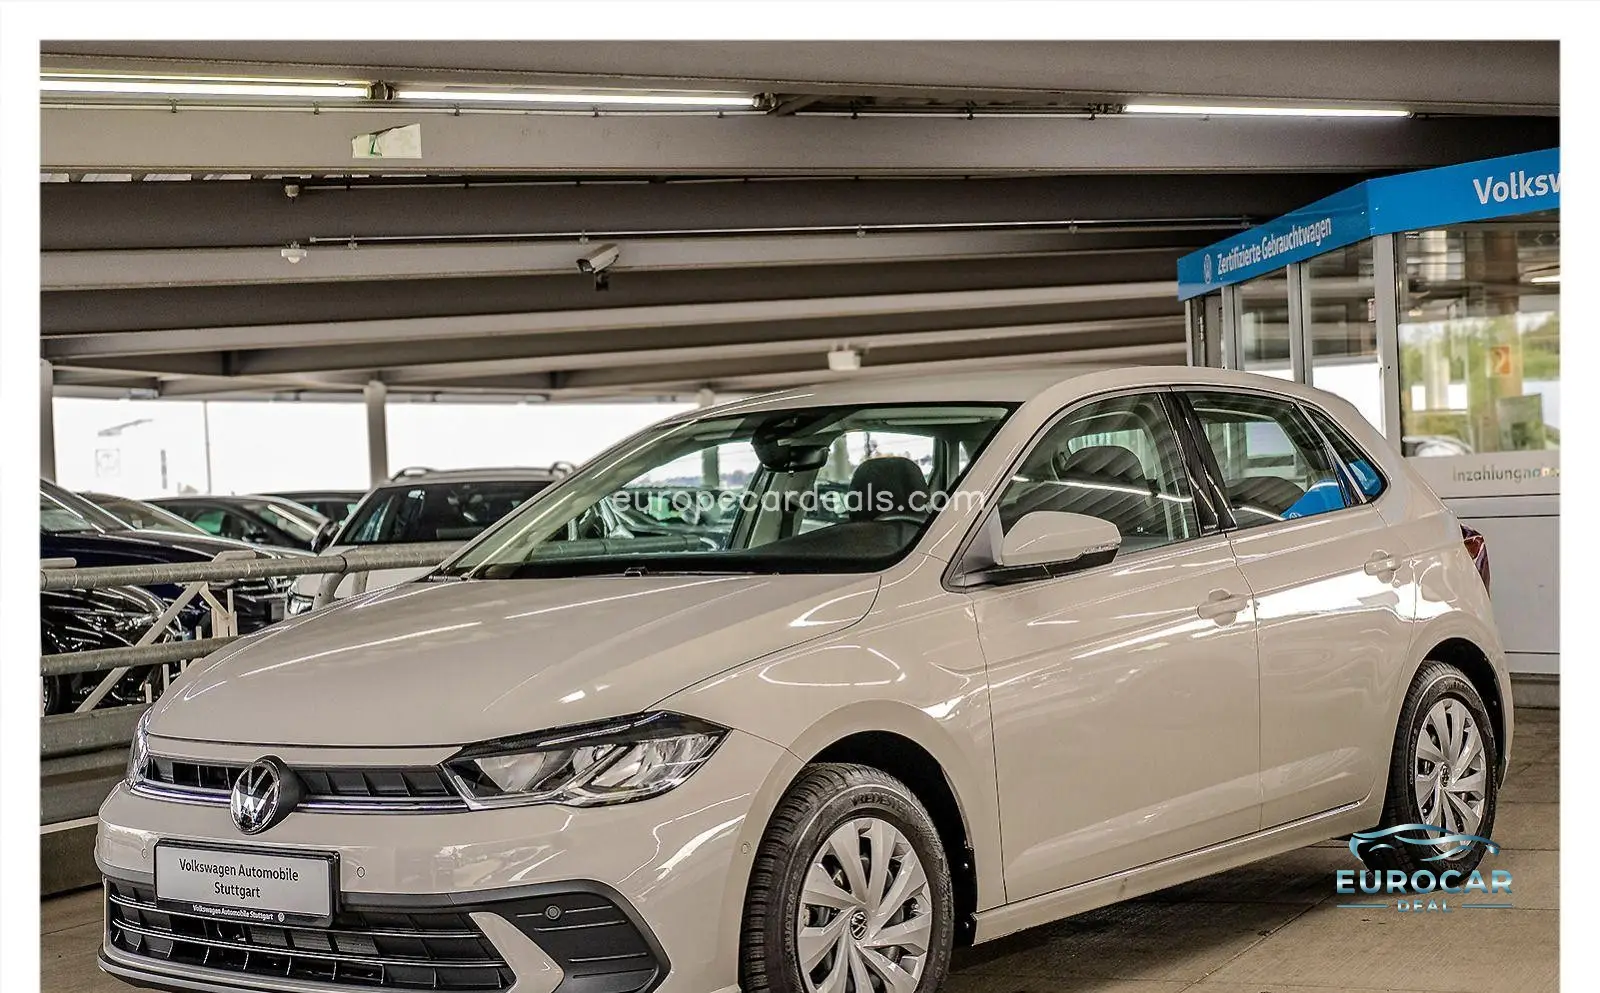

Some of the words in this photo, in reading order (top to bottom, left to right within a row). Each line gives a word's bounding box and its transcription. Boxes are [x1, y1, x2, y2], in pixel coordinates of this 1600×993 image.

[1217, 244, 1260, 275] Zertifizierte
[1261, 217, 1332, 259] Gebrauchtwagen
[179, 858, 236, 878] Volkswagen
[238, 864, 299, 882] Automobile
[214, 881, 261, 900] Stuttgart
[192, 904, 221, 916] Volkswagen
[220, 908, 250, 918] Automobile
[250, 910, 274, 921] Stuttgart
